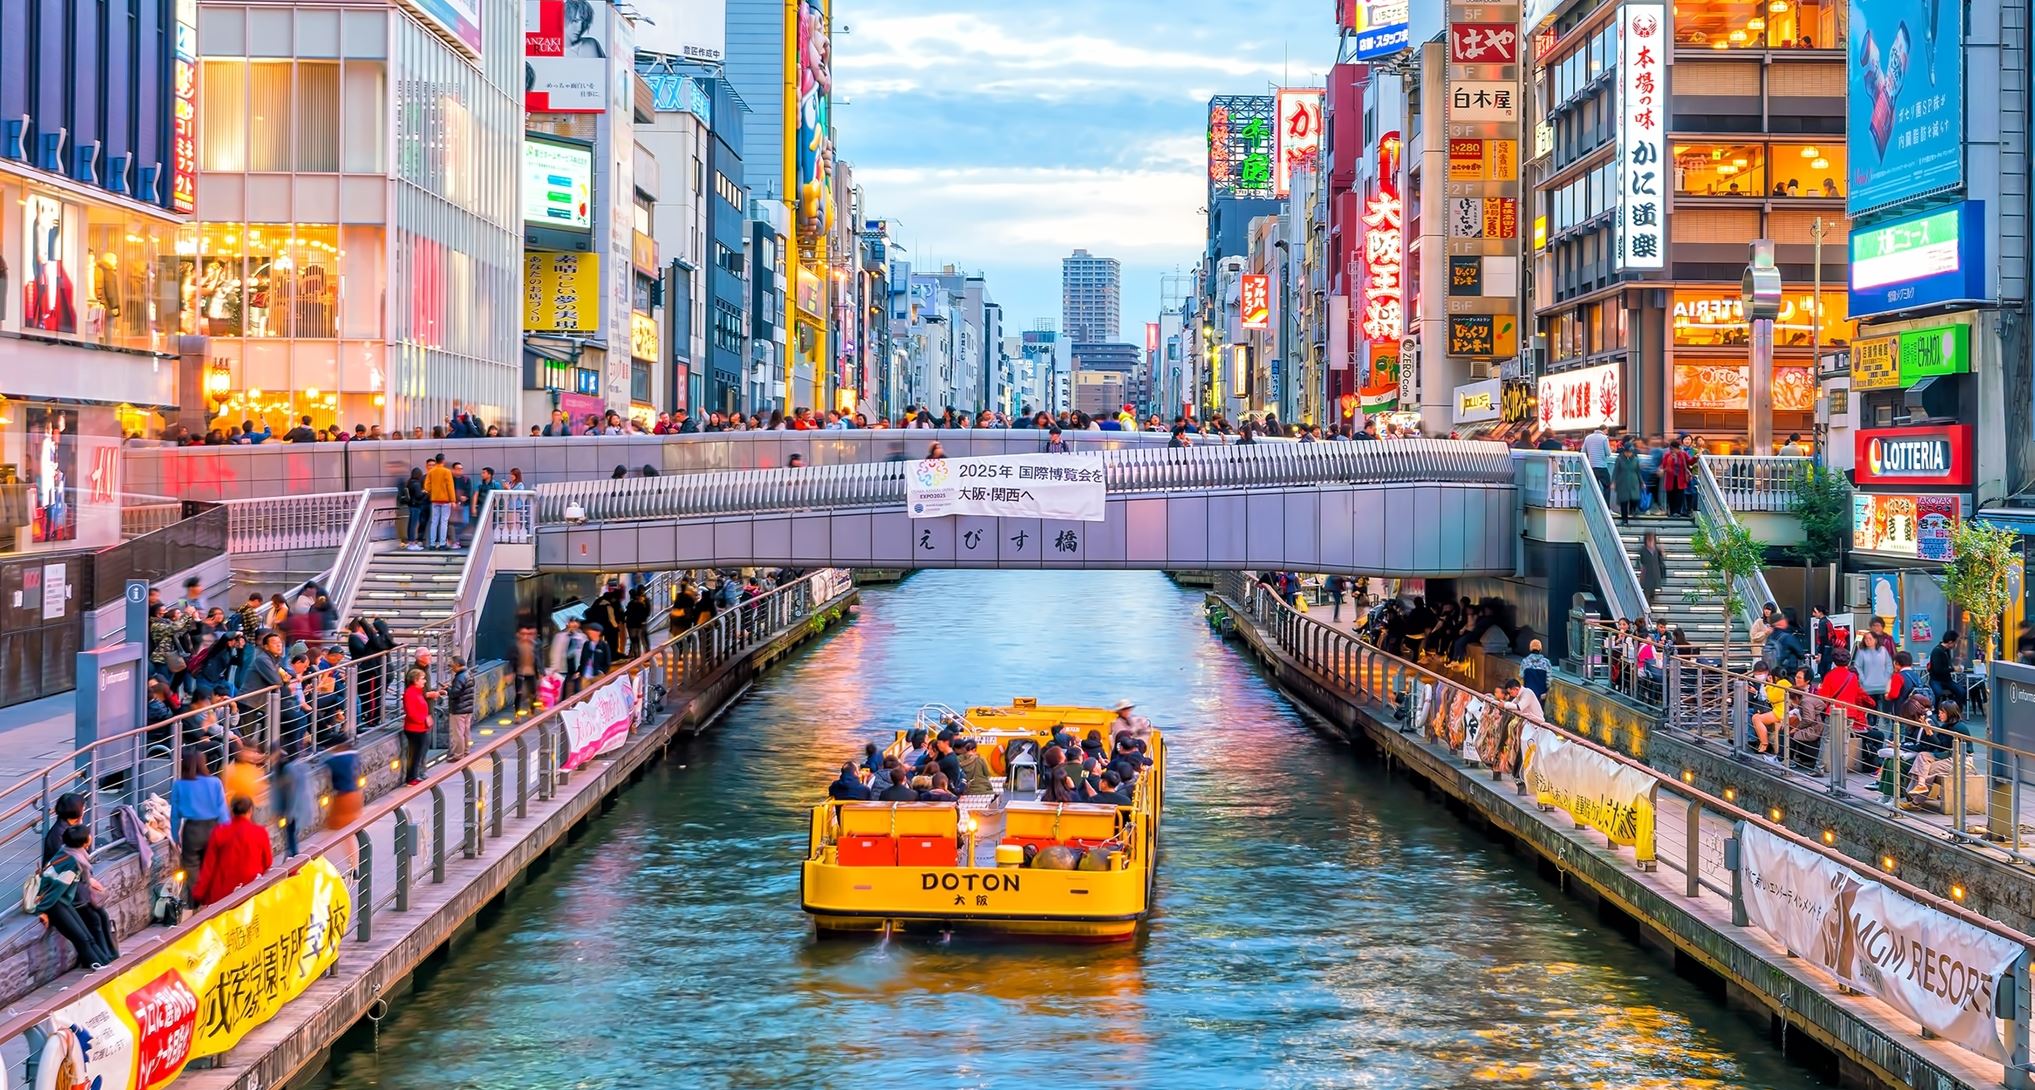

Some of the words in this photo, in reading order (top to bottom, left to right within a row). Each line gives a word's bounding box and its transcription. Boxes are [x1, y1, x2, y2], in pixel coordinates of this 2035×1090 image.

[1464, 8, 1482, 20] 5F
[1453, 28, 1515, 60] はや
[1454, 88, 1512, 109] 白木屋
[1633, 45, 1656, 131] 本場の味
[1362, 191, 1401, 341] 大阪王将
[554, 254, 578, 330] 素晴らしい夢の実現
[1455, 323, 1489, 338] びっくり
[1453, 338, 1491, 353] ドンキー
[1883, 440, 1944, 471] LOTTERIA
[959, 464, 1013, 479] 2025年
[1018, 465, 1103, 483] 国際博覧会を
[958, 486, 1035, 502] 大阪・関西へ
[919, 528, 1078, 553] えびす橋
[921, 873, 1021, 892] DOTON
[1852, 913, 1906, 974] MGM
[1906, 940, 1993, 1020] RESORTS
